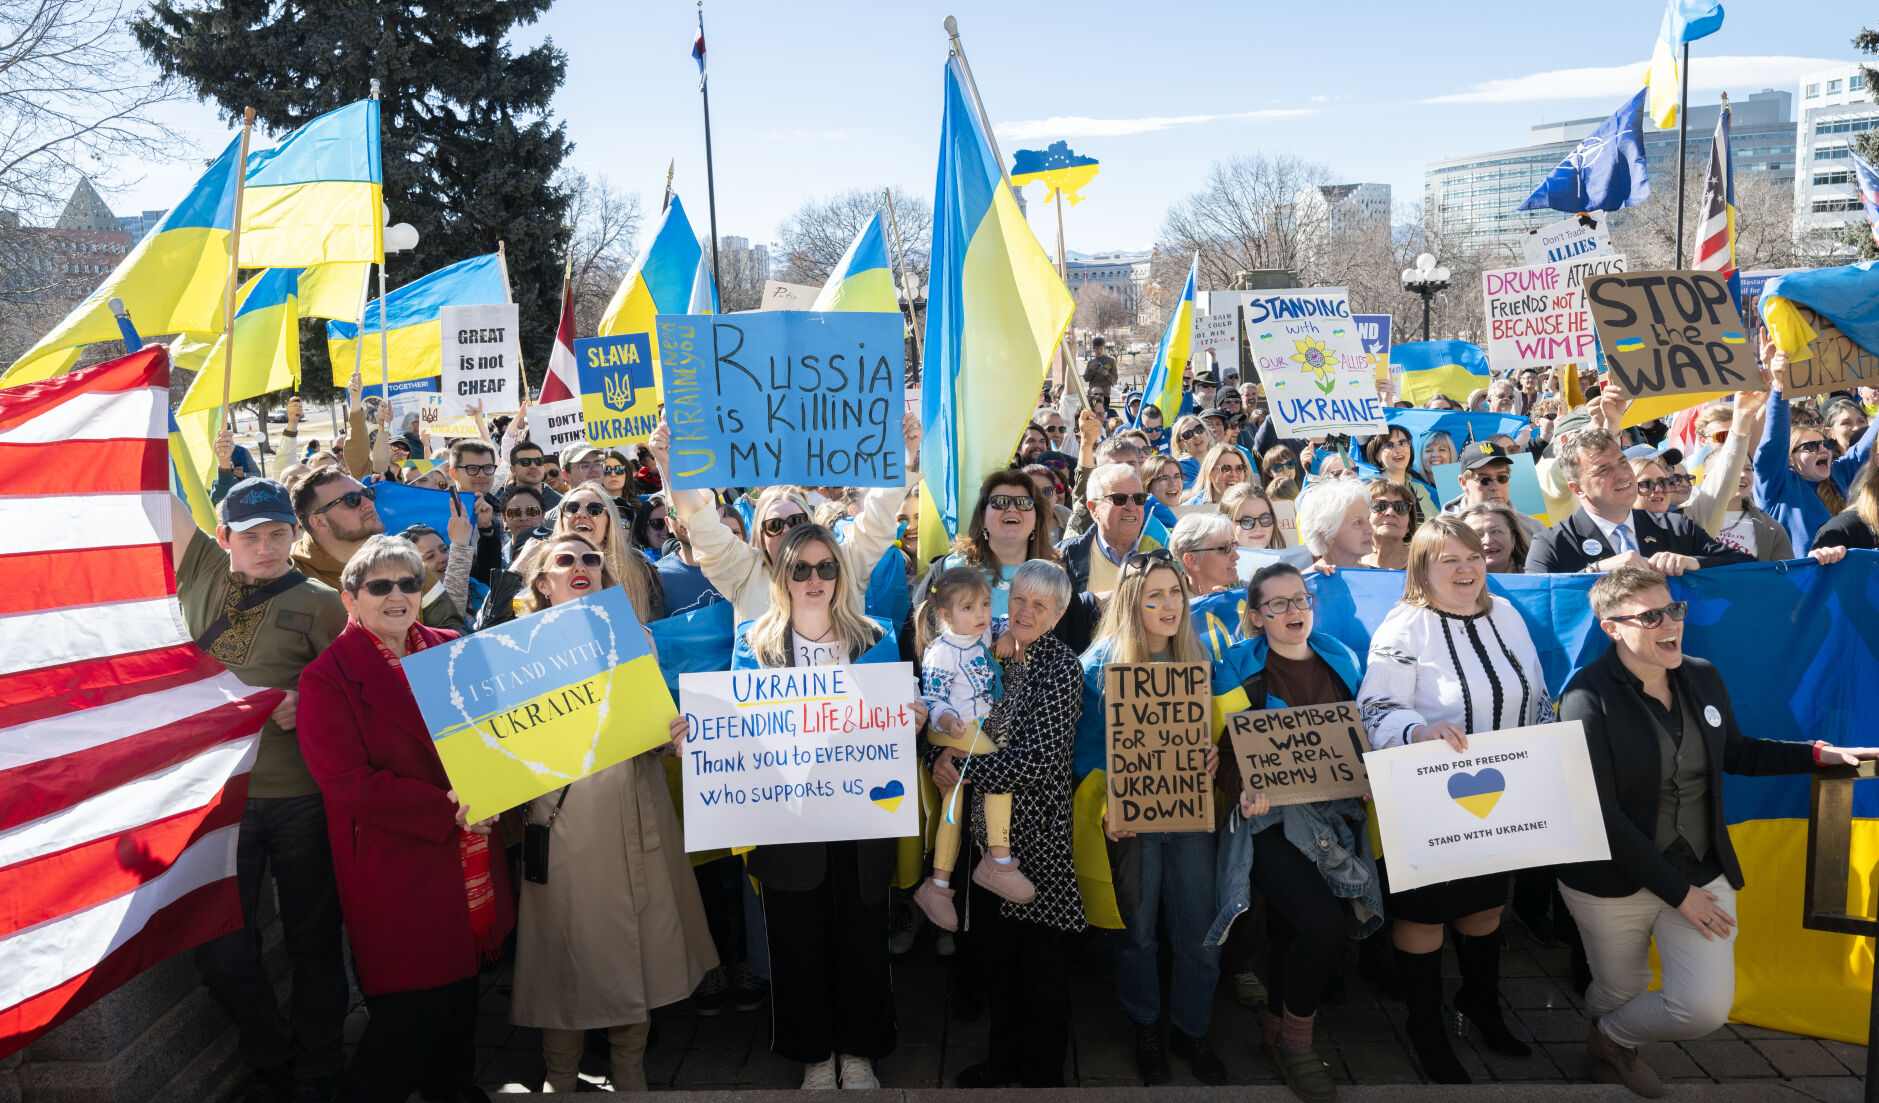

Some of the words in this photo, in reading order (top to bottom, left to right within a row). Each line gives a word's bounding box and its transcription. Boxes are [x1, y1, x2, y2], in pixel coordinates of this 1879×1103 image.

[1542, 233, 1565, 246] Don't
[1566, 227, 1587, 239] Trade
[1547, 237, 1597, 263] ALLIES
[1487, 266, 1560, 296] DRUMPF
[1250, 296, 1350, 324] STANDING
[1491, 295, 1548, 318] FRIENDS
[1552, 292, 1576, 310] NOT
[1589, 275, 1728, 327] STOP
[458, 327, 506, 344] GREAT
[1492, 314, 1564, 340] BECAUSE
[1568, 311, 1588, 332] HE
[1651, 324, 1705, 346] the
[587, 344, 640, 368] SLAVA
[1515, 334, 1595, 360] WIMP
[460, 355, 475, 370] is
[478, 354, 505, 369] not
[1259, 356, 1288, 369] OUR
[1341, 353, 1369, 370] ALLIES
[1607, 341, 1746, 396] WAR
[388, 381, 429, 393] TOGETHER!
[457, 378, 506, 396] CHEAP
[548, 413, 577, 428] DON'T
[716, 406, 744, 434] is
[1277, 397, 1384, 424] UKRAINE
[431, 424, 479, 434] UKRAINE
[730, 438, 782, 479] MY
[807, 437, 900, 480] HOME
[468, 684, 479, 702] I
[481, 660, 546, 698] STAND
[549, 639, 605, 671] WITH
[732, 670, 848, 703] UKRAINE
[489, 681, 602, 740] UKRAINE
[1110, 703, 1124, 727] I
[685, 709, 797, 743] DEFENDING
[1269, 730, 1322, 751] WHO
[793, 745, 811, 766] to
[1176, 748, 1208, 772] LET
[1417, 763, 1450, 776] STAND
[1452, 759, 1473, 771] FOR
[1475, 750, 1528, 766] FREEDOM!
[1111, 772, 1209, 798] UKRAINE
[1428, 834, 1461, 847] STAND
[1464, 829, 1493, 841] WITH
[1495, 821, 1547, 835] UKRAINE!
